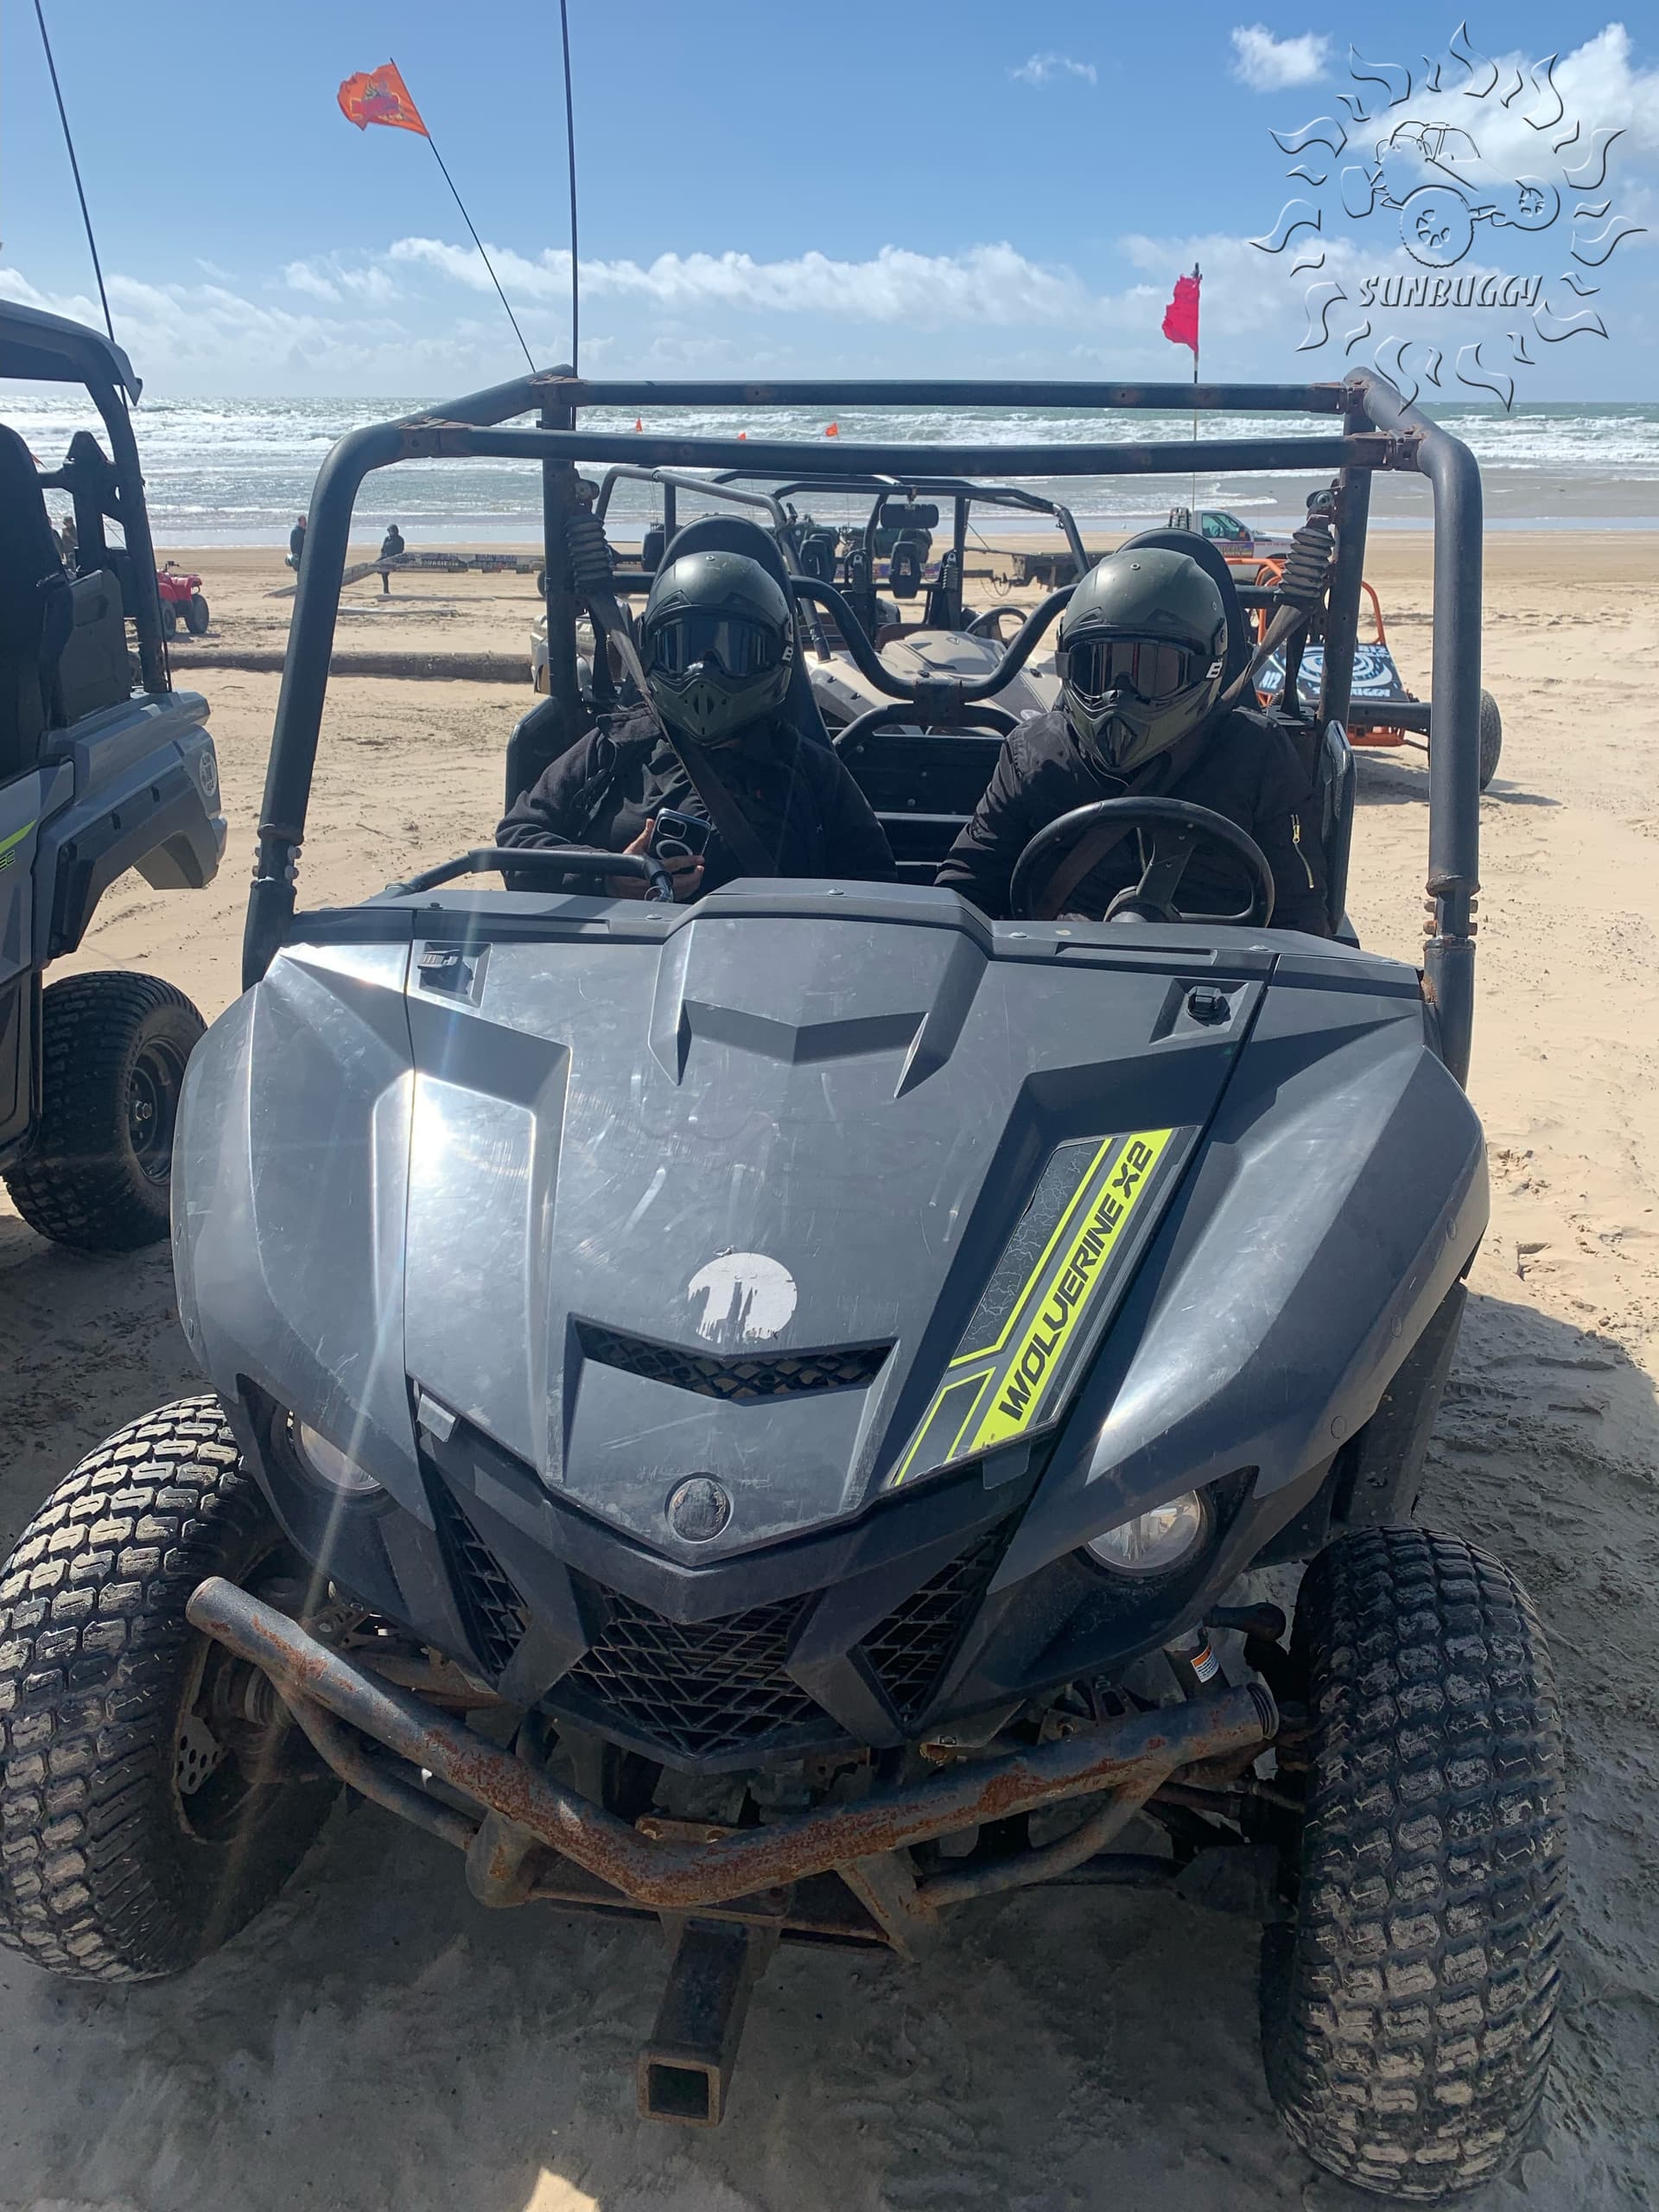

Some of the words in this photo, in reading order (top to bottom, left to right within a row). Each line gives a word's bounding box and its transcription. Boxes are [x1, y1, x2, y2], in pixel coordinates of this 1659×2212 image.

[1205, 662, 1223, 678] B
[998, 1193, 1123, 1421] WOLVERINE
[1111, 1140, 1154, 1199] X2
